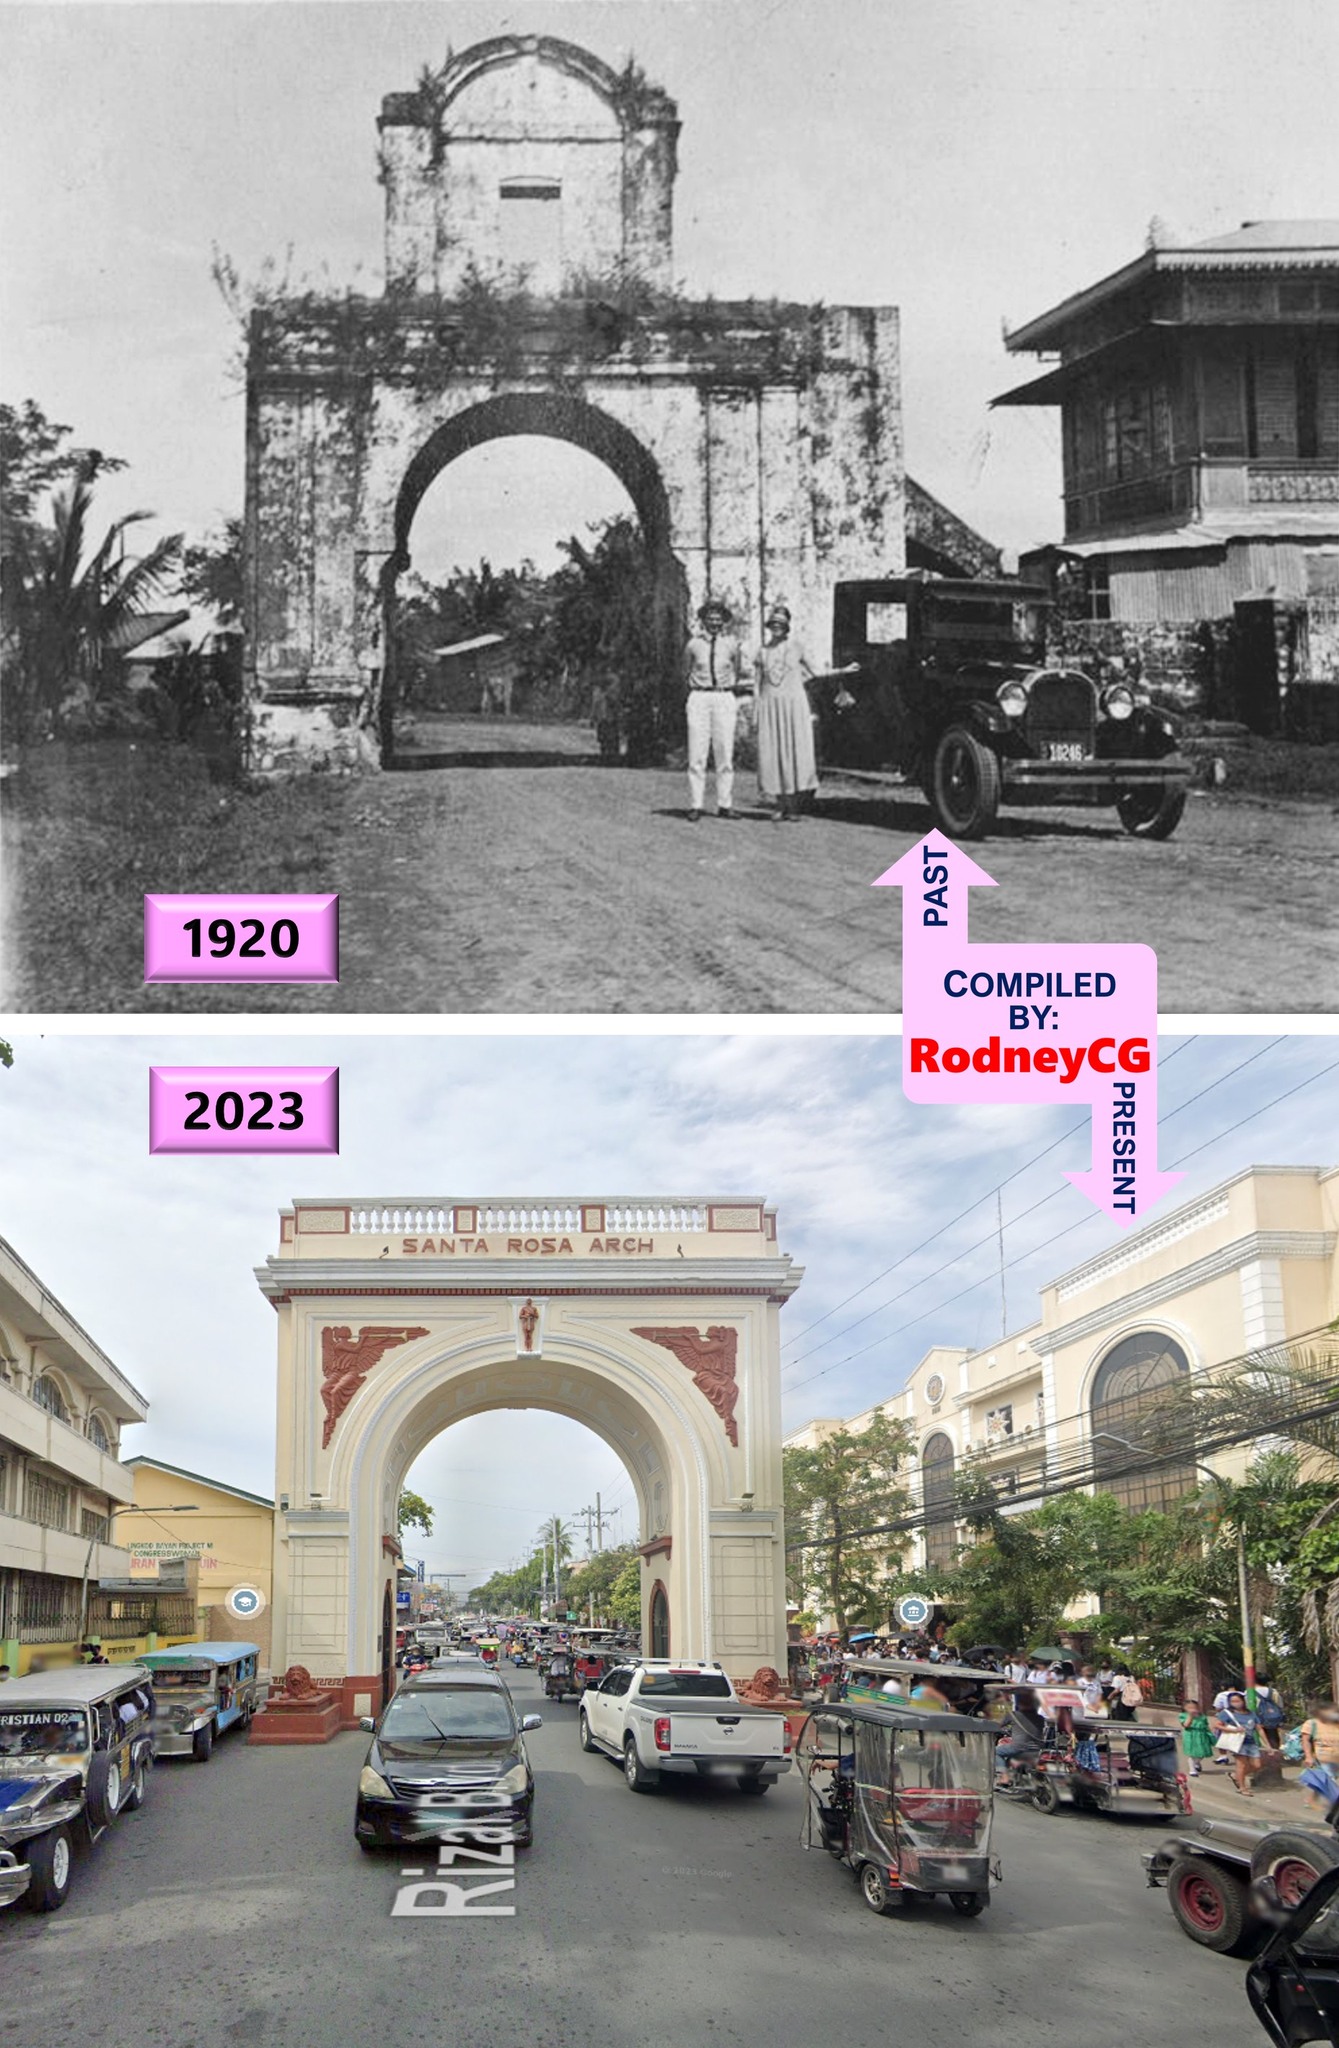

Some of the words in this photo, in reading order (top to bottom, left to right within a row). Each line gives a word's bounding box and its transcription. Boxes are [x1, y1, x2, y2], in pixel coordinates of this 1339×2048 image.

[402, 1238, 489, 1254] SANTA
[507, 1237, 573, 1254] ROSA
[589, 1237, 654, 1254] ARCH
[0, 1713, 51, 1726] RISTIAN
